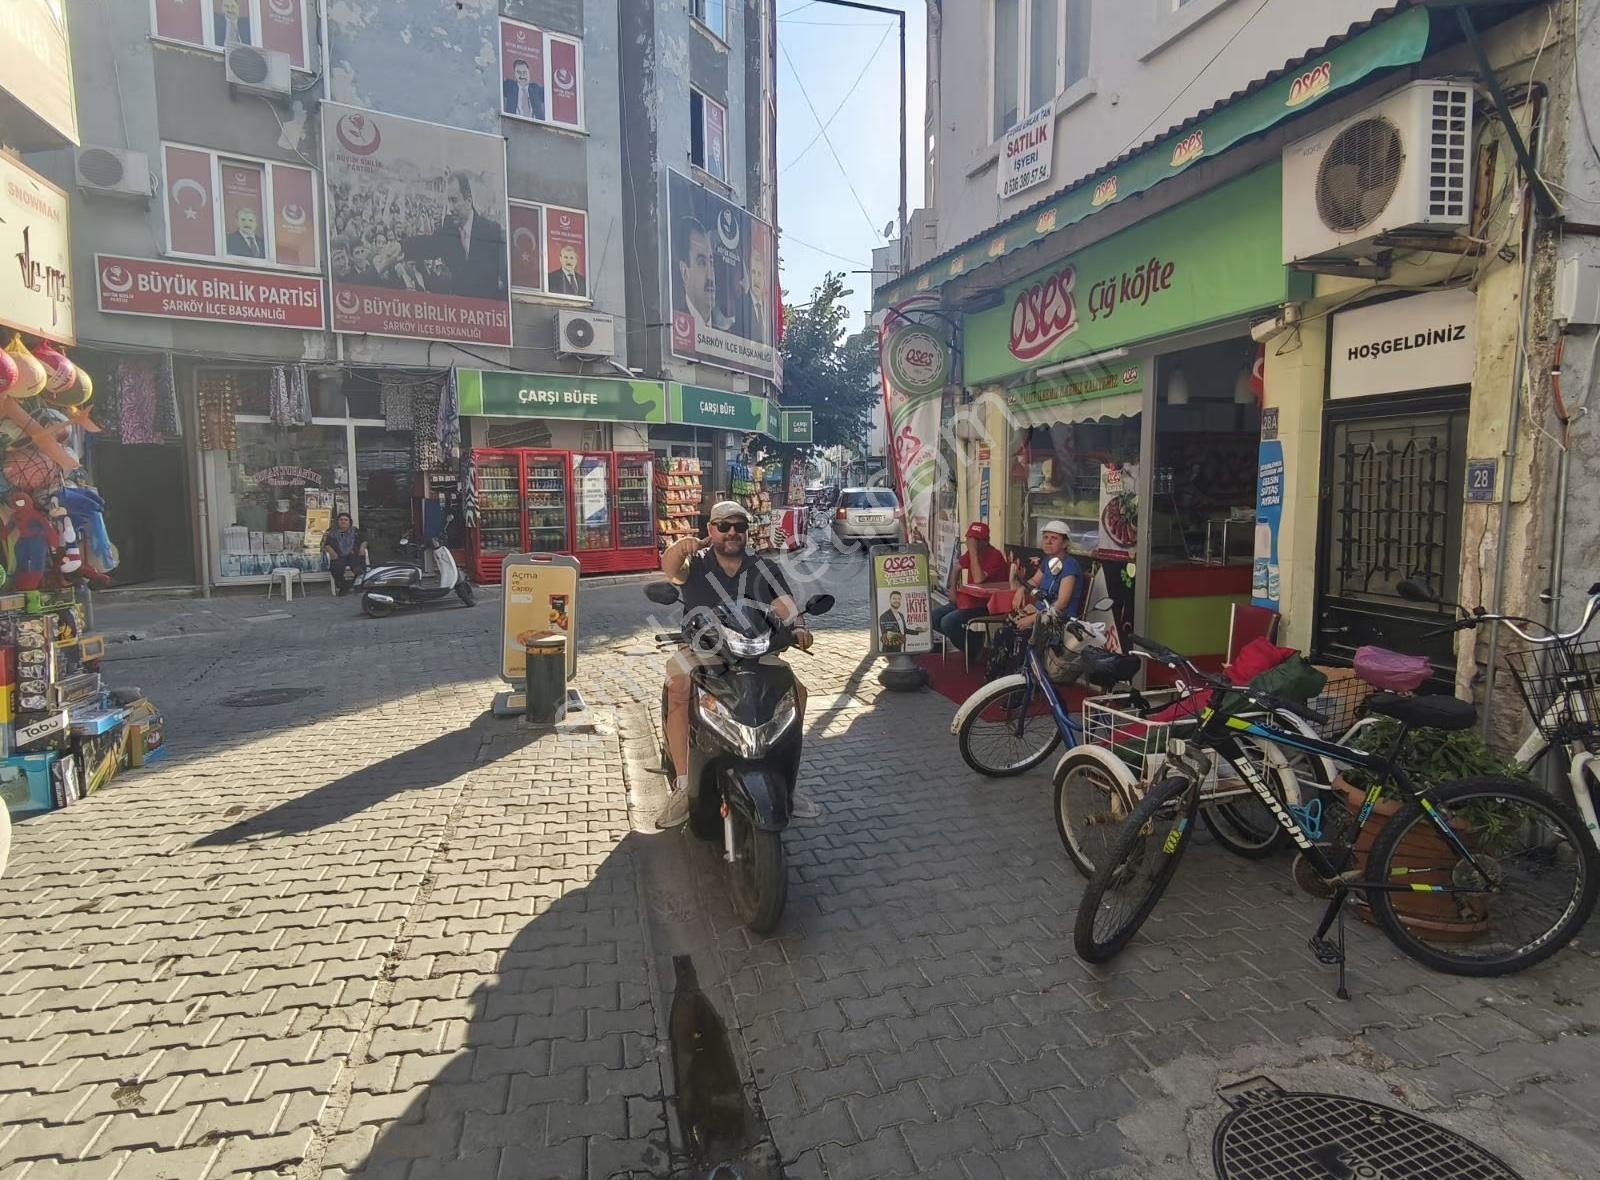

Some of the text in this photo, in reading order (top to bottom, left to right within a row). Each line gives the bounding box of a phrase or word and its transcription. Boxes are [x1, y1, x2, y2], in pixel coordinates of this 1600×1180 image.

[1007, 123, 1048, 158] SATILIK
[1014, 148, 1039, 172] İŞYERİ
[8, 182, 60, 223] SNOWMAN
[138, 271, 318, 308] BÜYÜK BİRLİK PARTİSİ
[1088, 277, 1116, 321] Çiğ
[1119, 256, 1175, 308] köfte
[162, 299, 286, 320] ŞARKÖY İLÇE BAŞKANLIĞI
[363, 296, 507, 328] BÜYÜK BİRLİK PARTİSİ
[697, 333, 724, 349] ŞARKÖY
[724, 341, 738, 354] İLÇE
[739, 346, 772, 362] BAŞKANLIĞI
[1348, 324, 1466, 360] HOŞGELDİNİZ
[518, 389, 599, 405] ÇARŞI BÜFE
[699, 400, 736, 416] ÇARŞI BÜFE
[1262, 415, 1277, 431] 28A
[1473, 470, 1489, 488] 28
[511, 571, 538, 580] Açma
[511, 585, 533, 593] Cappy
[22, 719, 59, 738] Tabu
[1233, 756, 1316, 849] Bianchi
